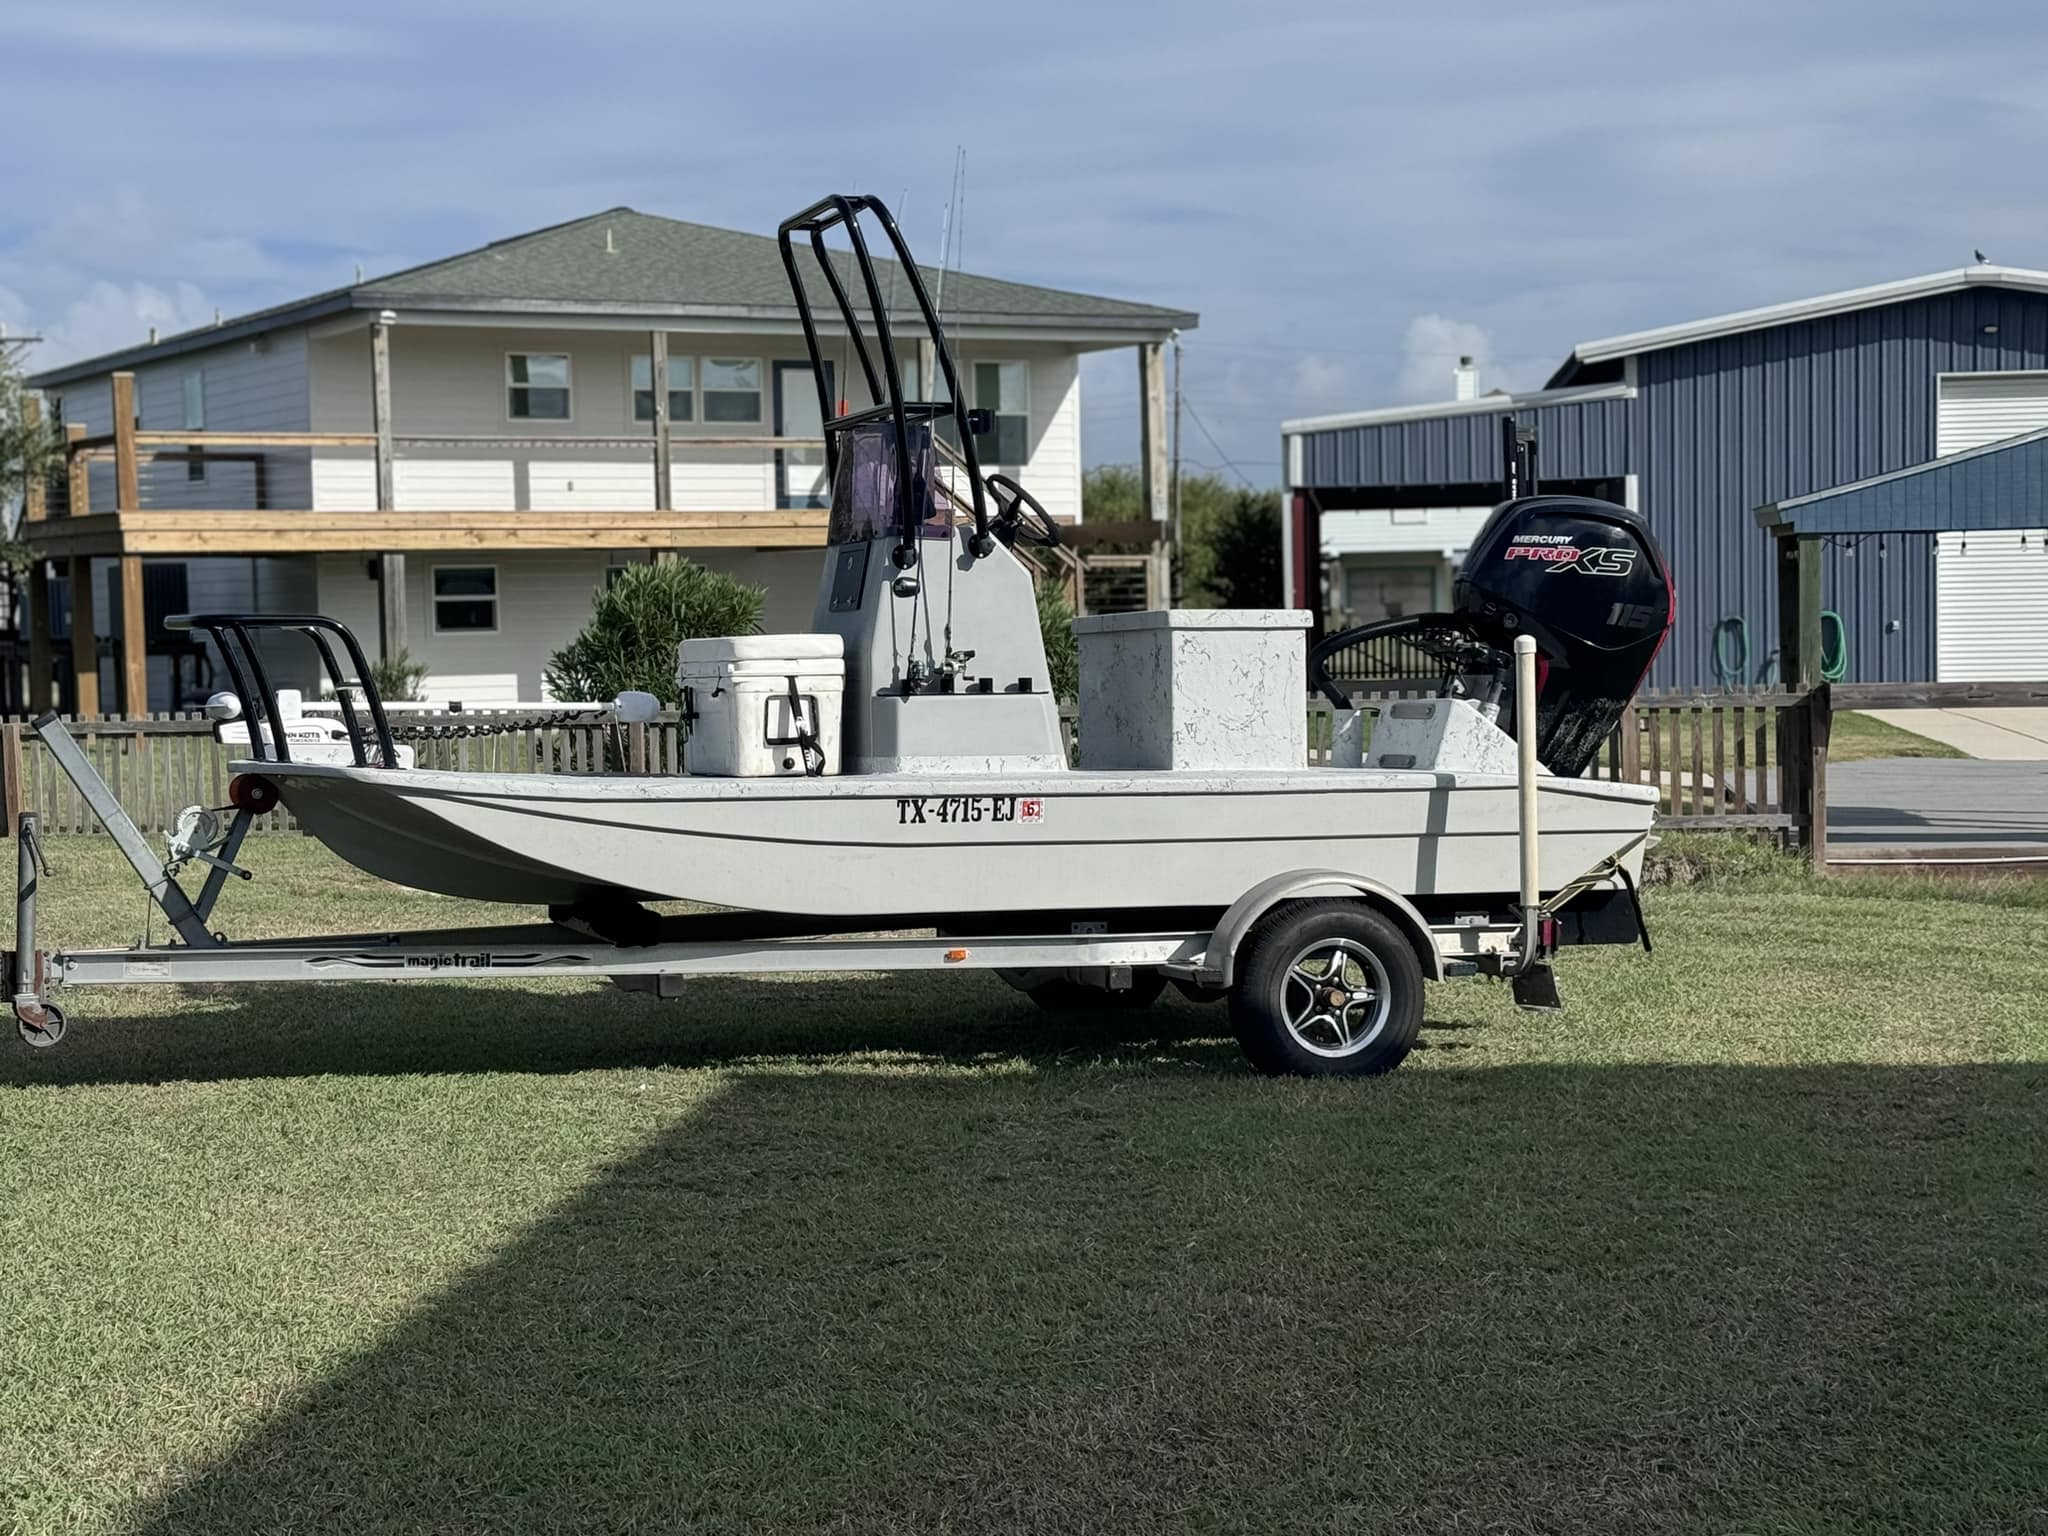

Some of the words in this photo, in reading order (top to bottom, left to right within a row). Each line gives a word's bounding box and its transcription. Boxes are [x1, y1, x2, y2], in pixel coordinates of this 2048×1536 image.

[1512, 535, 1574, 544] MERCURY
[1606, 602, 1656, 629] 115
[897, 797, 1016, 824] TX-4715-EJ
